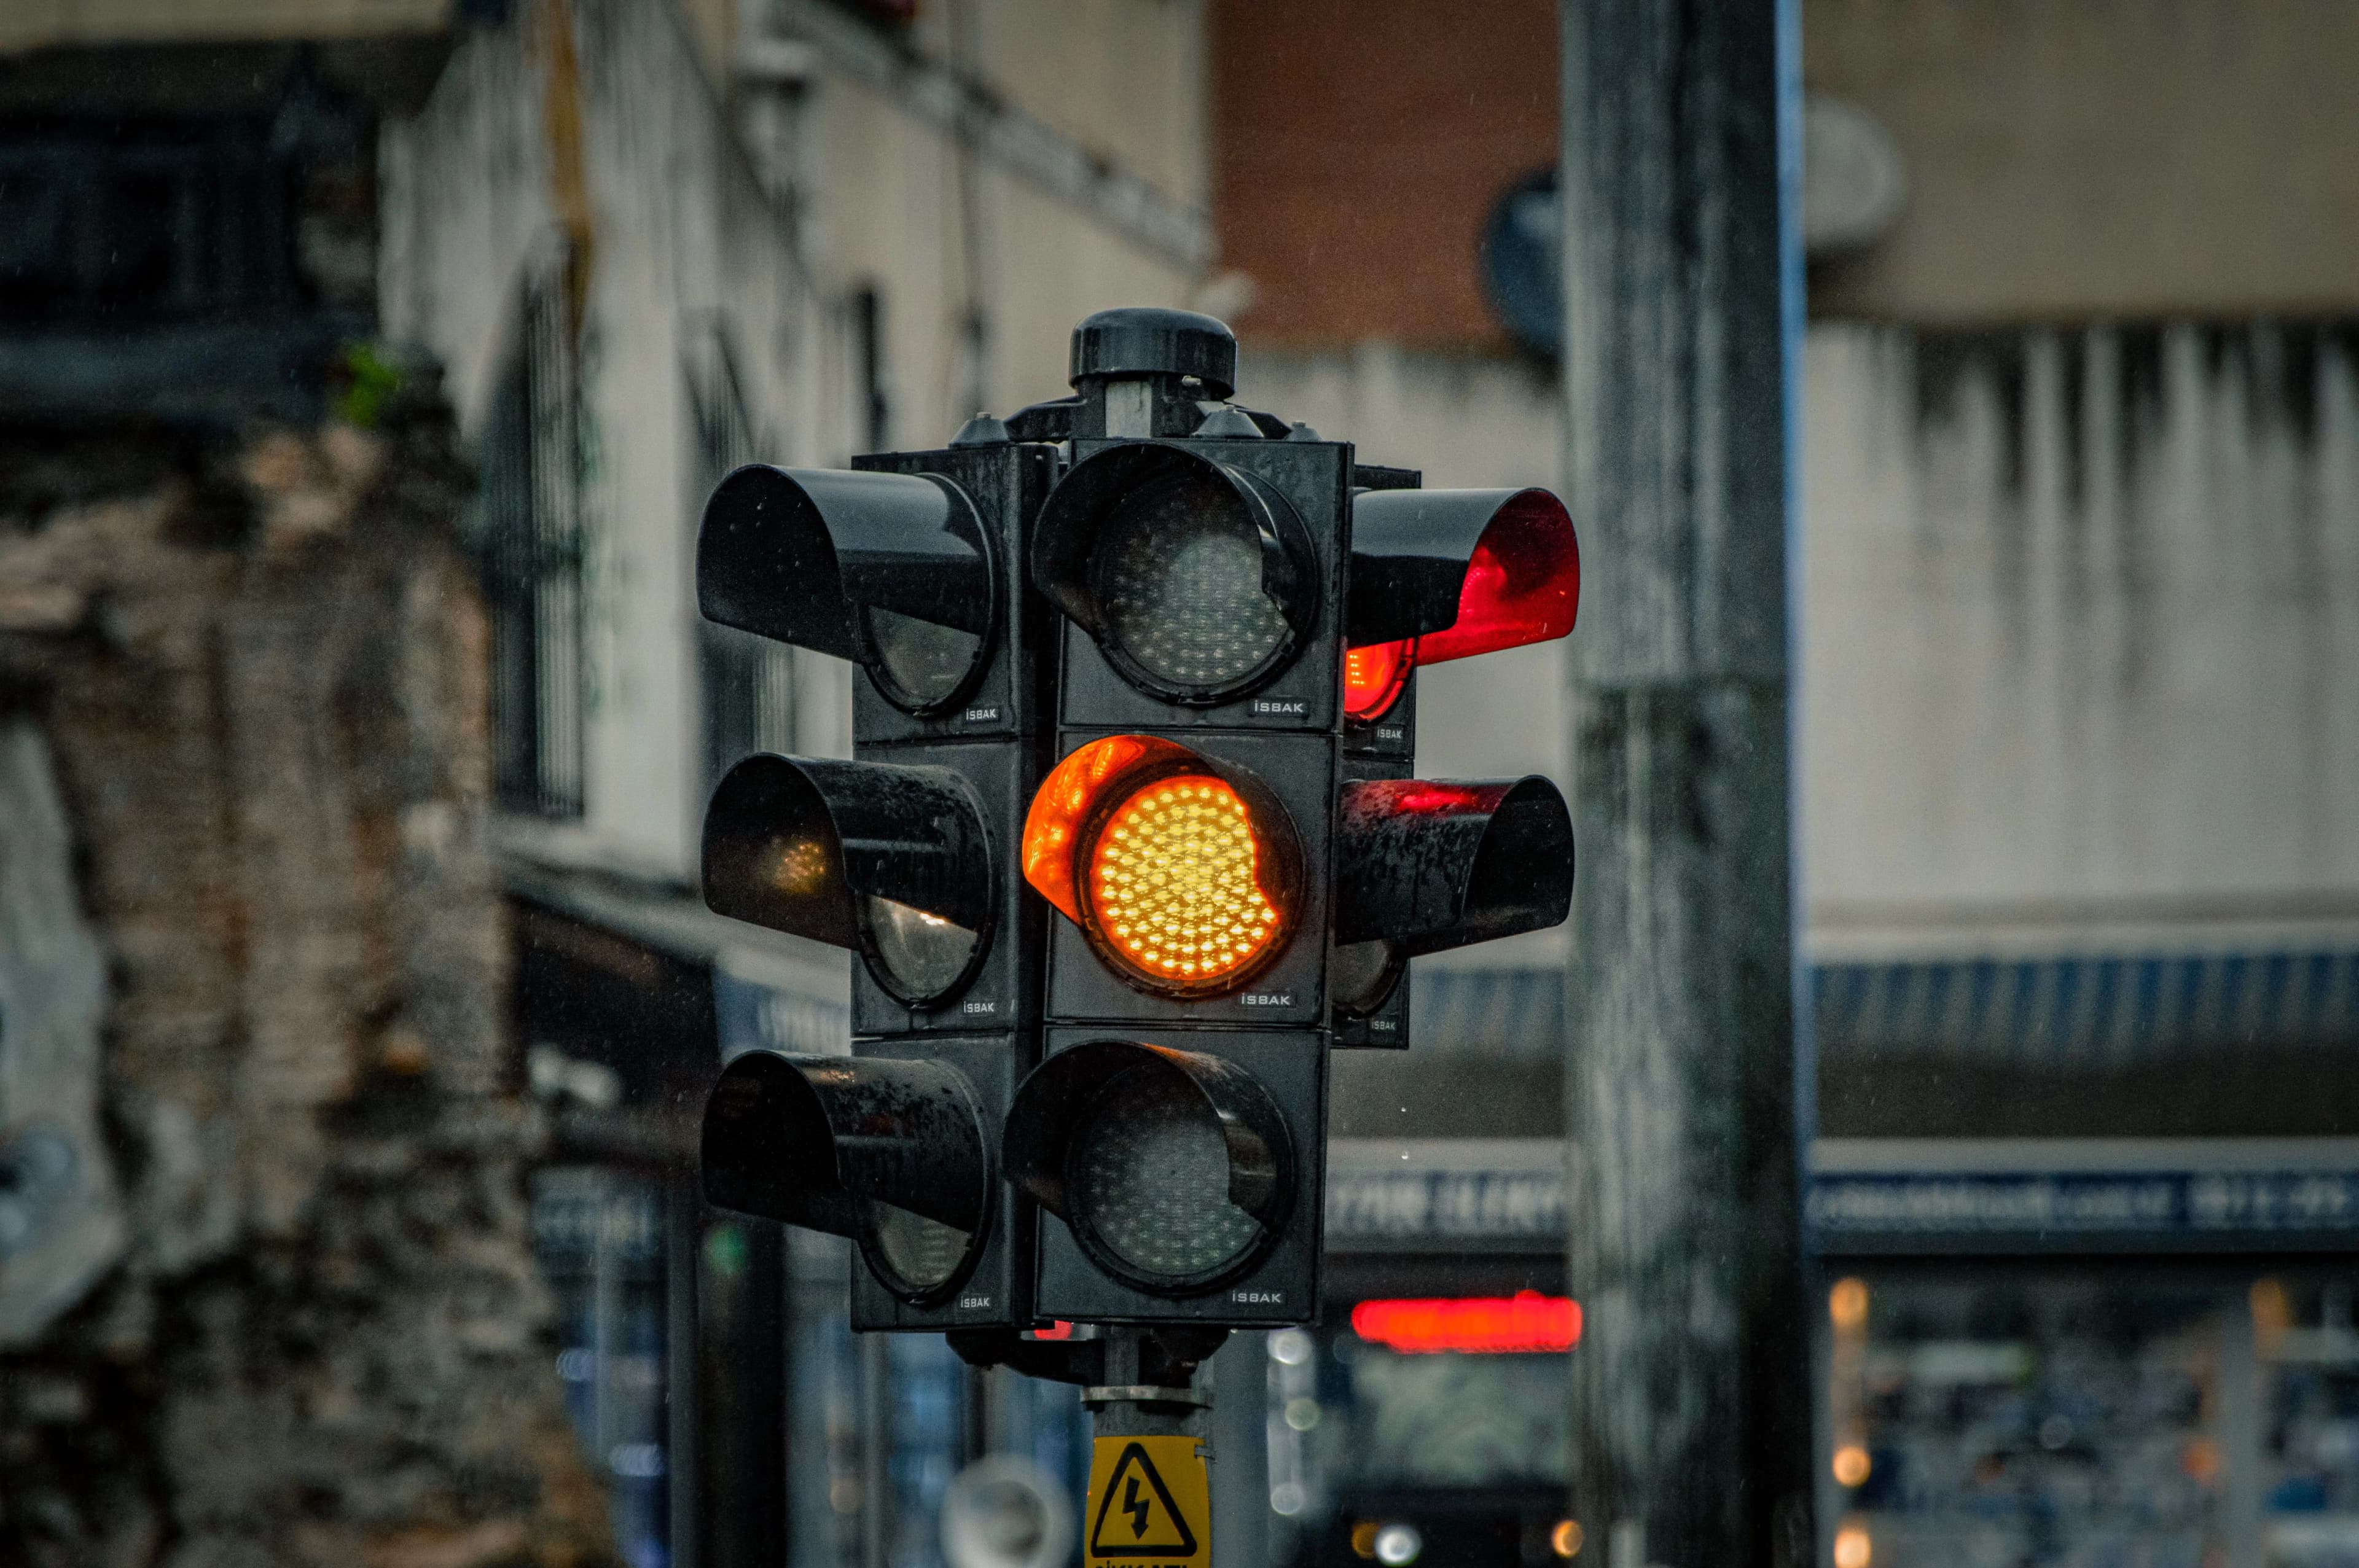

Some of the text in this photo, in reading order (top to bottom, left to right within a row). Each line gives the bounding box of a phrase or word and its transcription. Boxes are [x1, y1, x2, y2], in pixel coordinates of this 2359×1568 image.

[1254, 700, 1303, 712] İSBAK
[966, 708, 996, 720] İSBAK
[1241, 993, 1290, 1005] İSBAK
[963, 1000, 994, 1013] İSBAK
[961, 1296, 990, 1308] İSBAK
[1232, 1290, 1281, 1303] İSBAK
